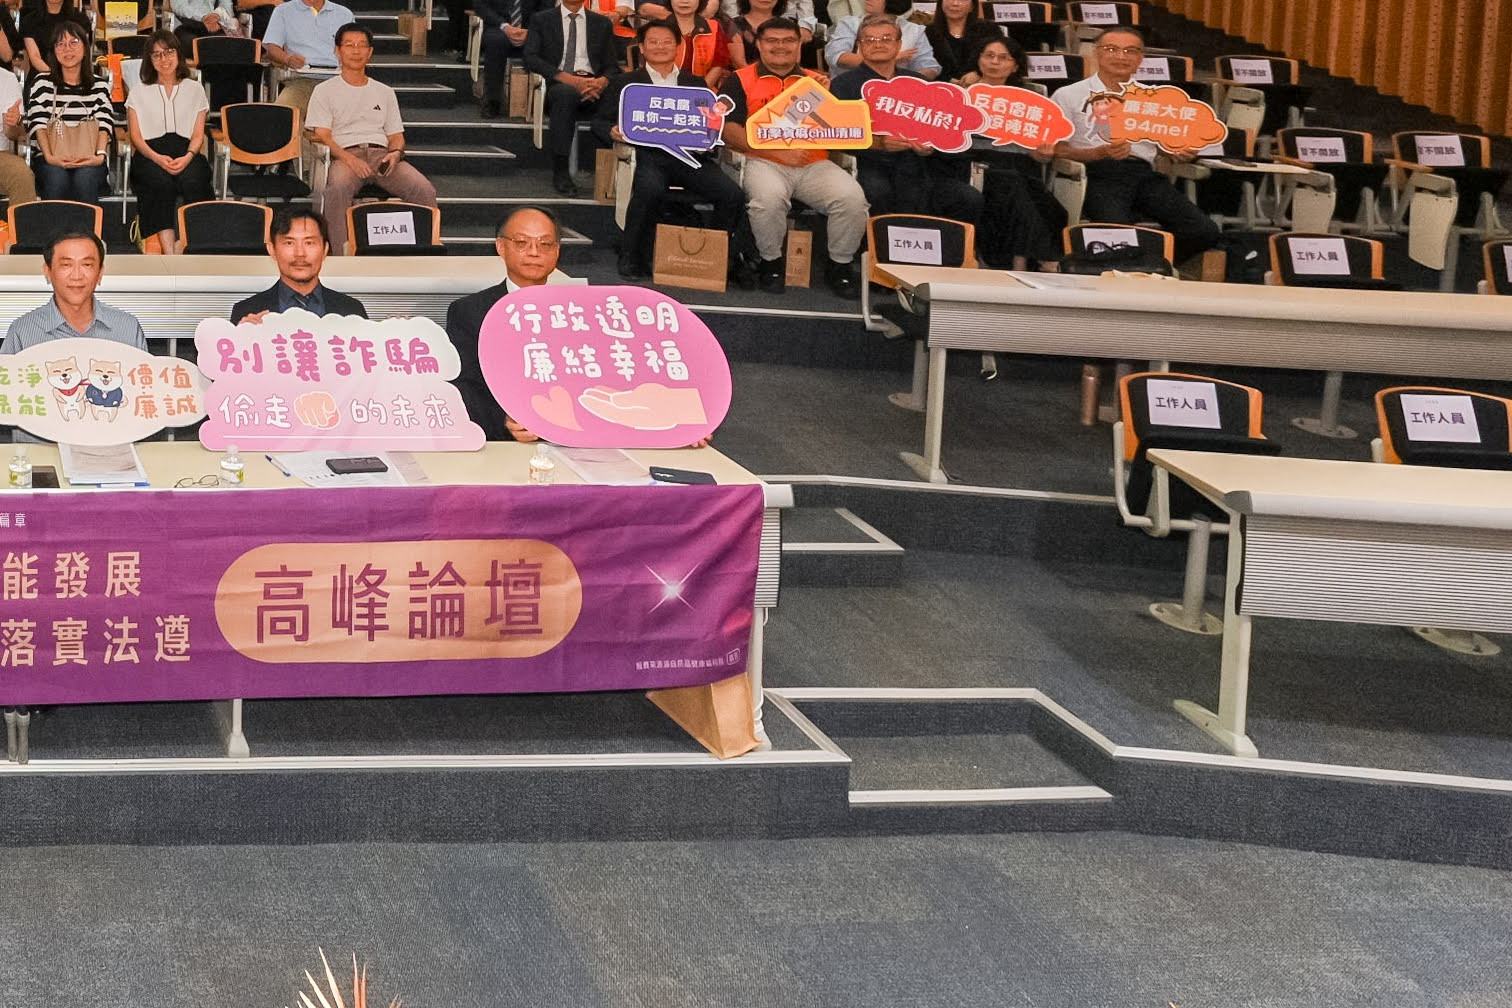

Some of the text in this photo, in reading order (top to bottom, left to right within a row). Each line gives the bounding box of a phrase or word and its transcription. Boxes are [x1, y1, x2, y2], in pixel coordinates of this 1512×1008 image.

[649, 96, 690, 112] 反貪腐
[875, 95, 963, 131] 我反私菸!
[1122, 99, 1198, 121] 廉潔大使
[631, 110, 707, 128] 廉你一起來!
[1123, 117, 1189, 137] 94me!
[372, 223, 408, 235] 工作人員
[893, 238, 934, 251] 工作人員
[1296, 250, 1339, 262] 工作人員
[505, 295, 680, 339] 行政透明
[216, 328, 440, 382] 別讓詐騙
[523, 337, 690, 384] 廉結幸福
[127, 363, 193, 390] 價值
[133, 391, 199, 420] 廉誠
[218, 393, 455, 429] 偷走 的未來
[1154, 396, 1209, 412] 工作人員
[1410, 411, 1466, 426] 工作人員
[253, 557, 544, 645] 高峰論壇
